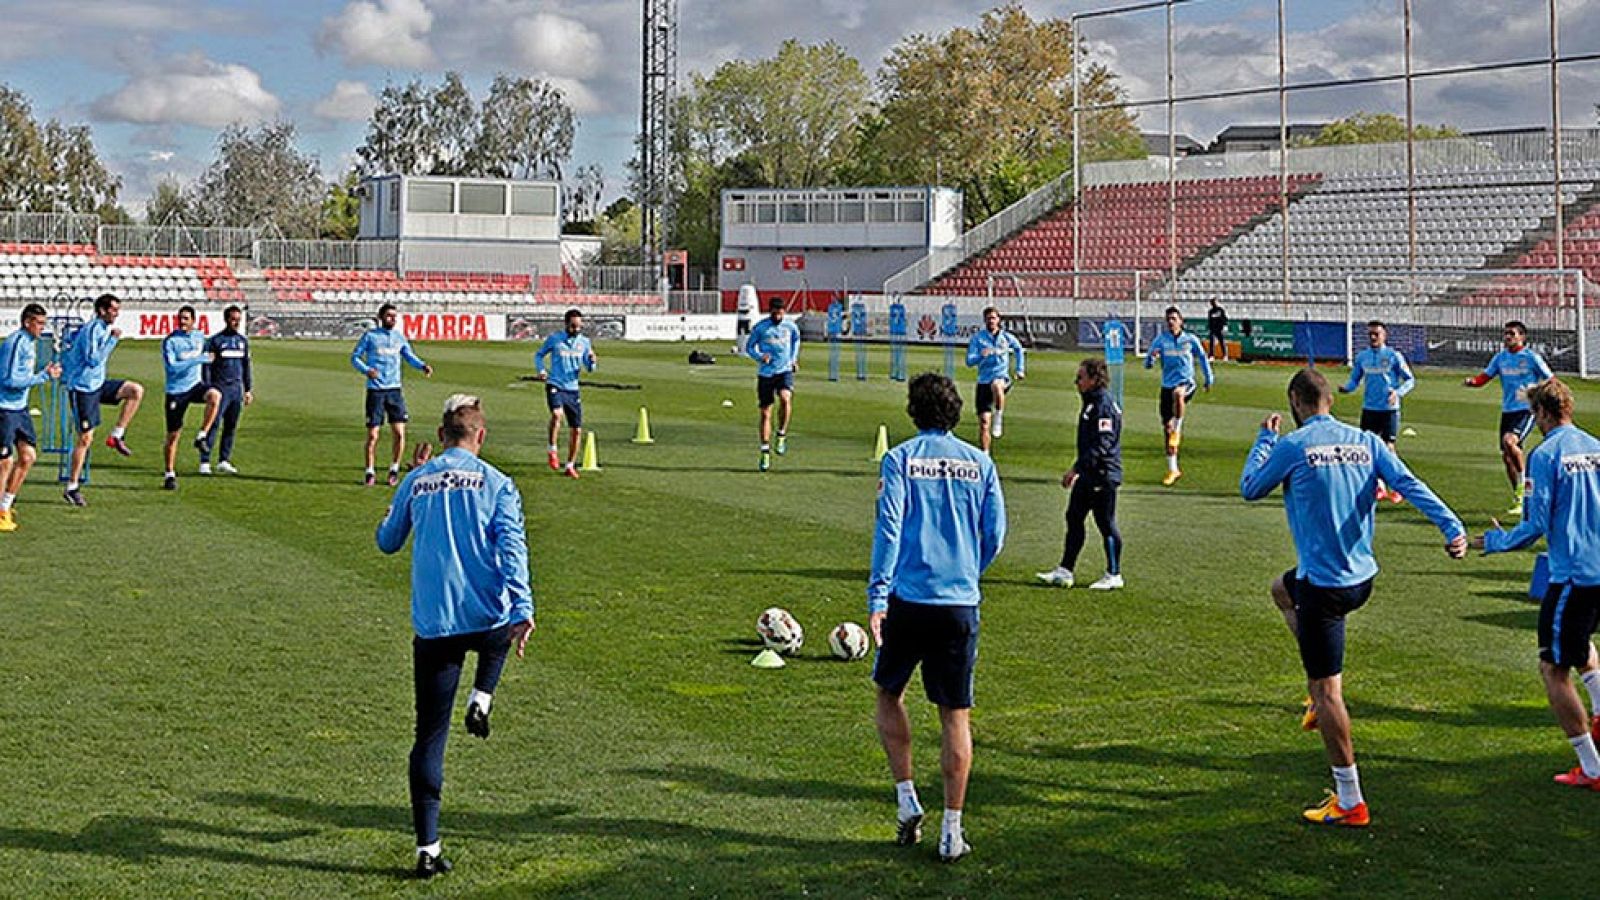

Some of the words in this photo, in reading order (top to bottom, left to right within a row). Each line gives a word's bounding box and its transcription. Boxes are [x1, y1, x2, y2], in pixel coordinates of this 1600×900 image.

[140, 315, 210, 335] MAA
[403, 314, 489, 339] MARCA
[1308, 449, 1371, 466] Plus500
[909, 462, 980, 480] Plus500
